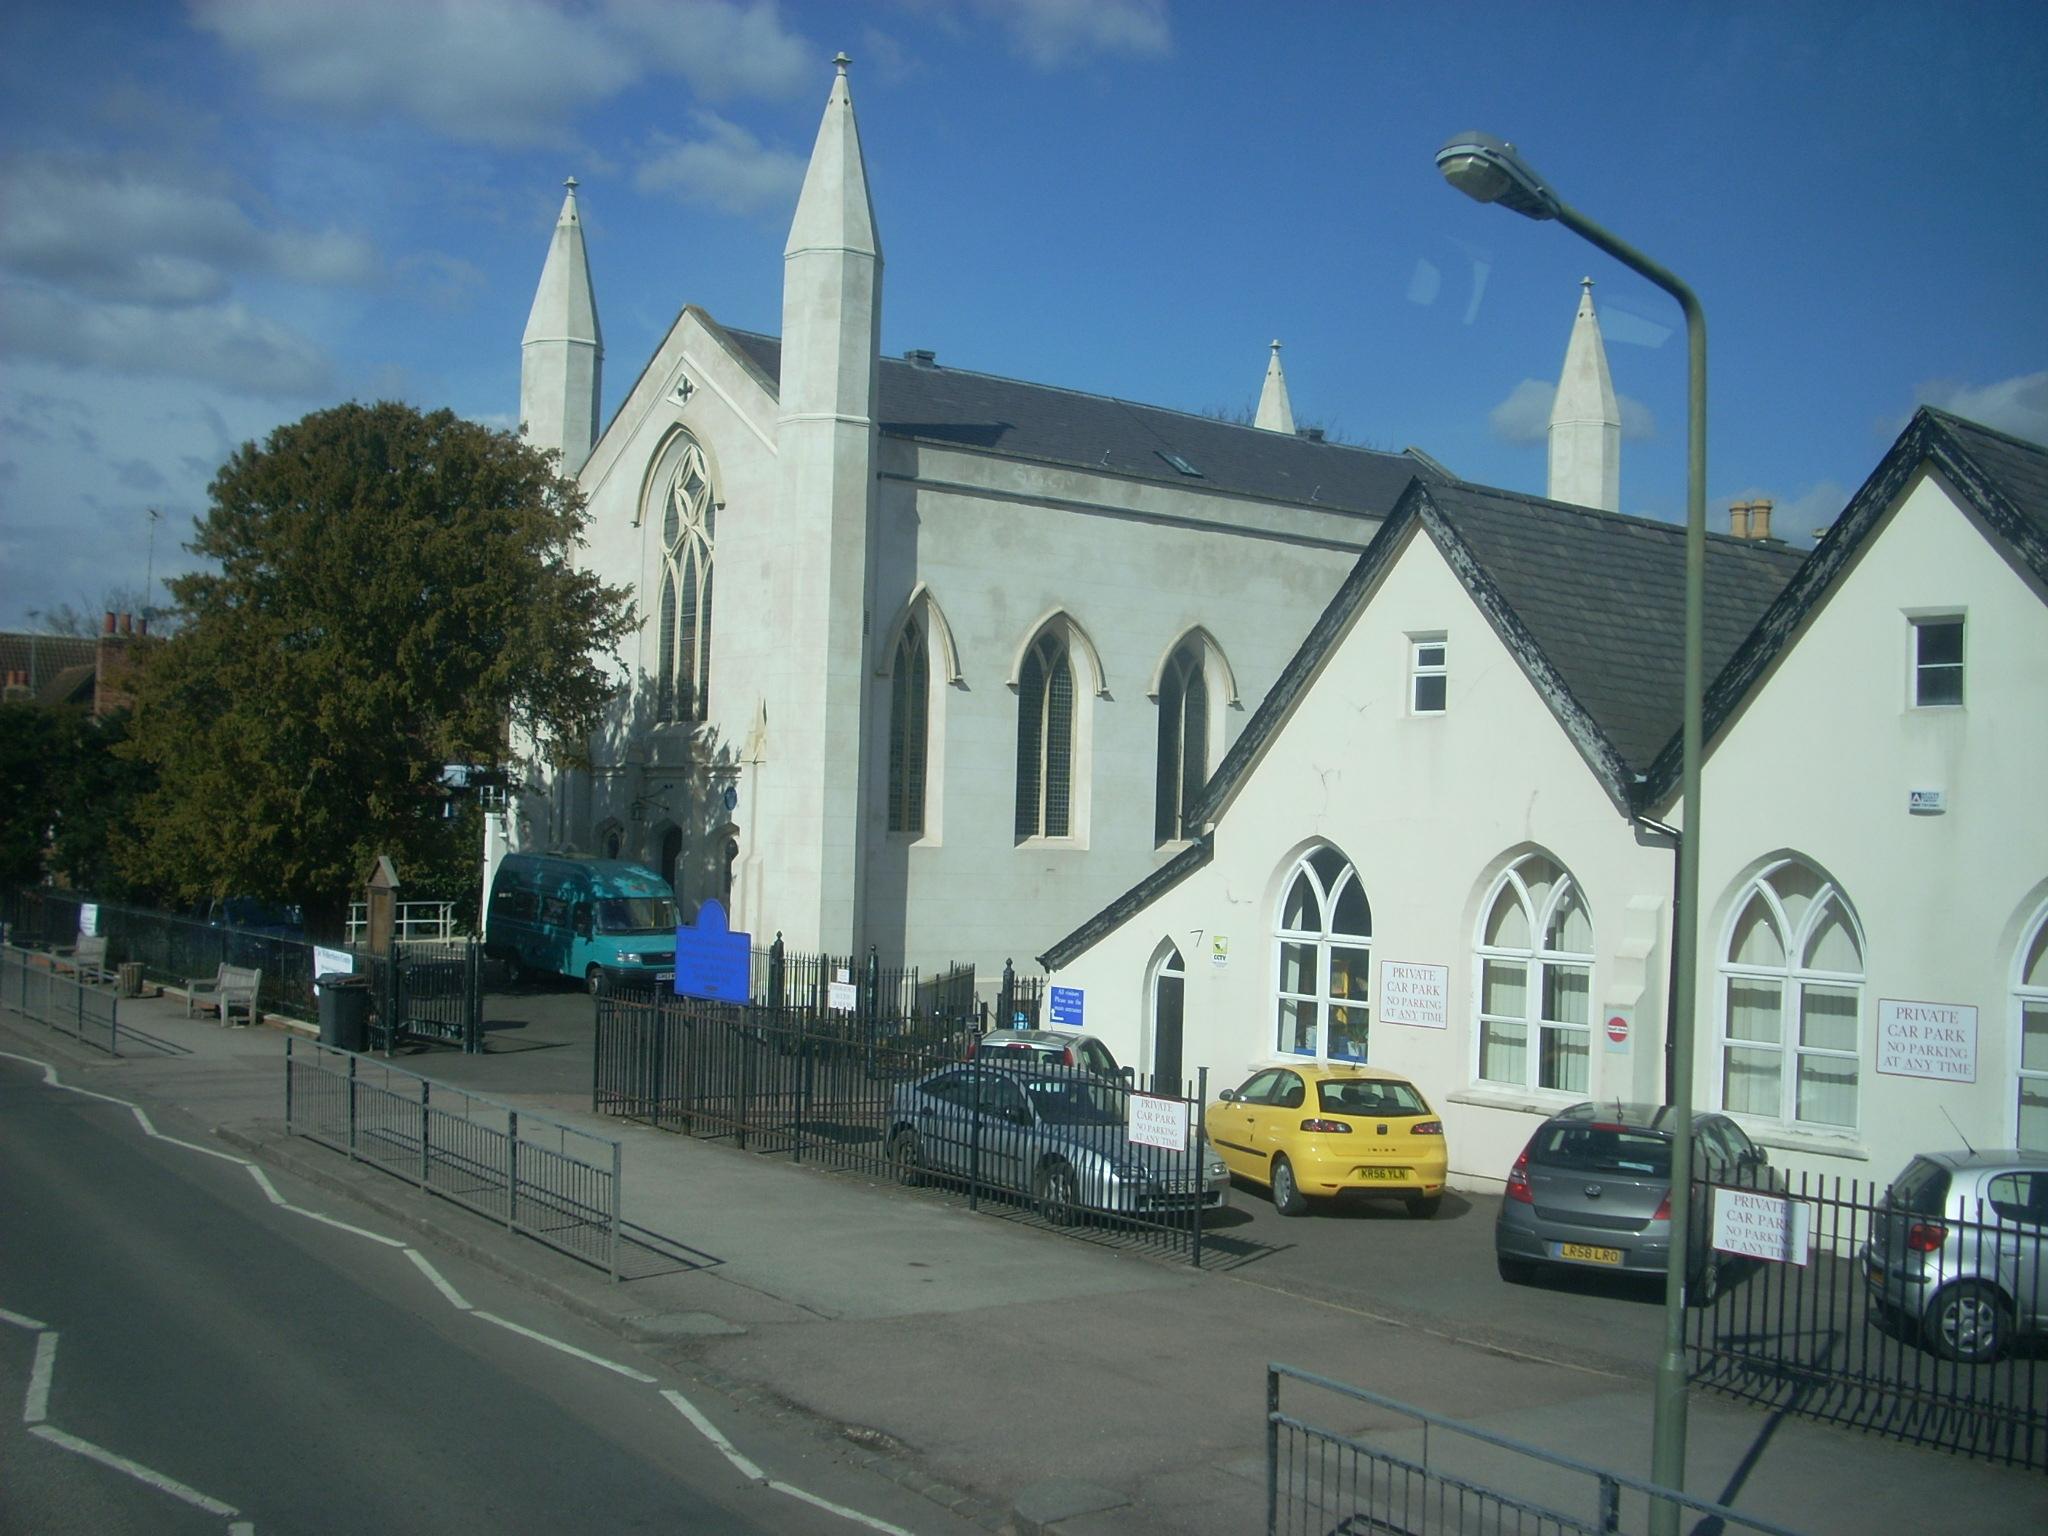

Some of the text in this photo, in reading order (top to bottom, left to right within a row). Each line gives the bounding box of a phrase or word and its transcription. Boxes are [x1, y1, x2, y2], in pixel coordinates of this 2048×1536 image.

[1393, 967, 1436, 981] PRIVATE
[1387, 981, 1440, 996] CAR PARK
[1387, 996, 1441, 1010] NO PARKING
[1385, 1008, 1443, 1022] AT ANY TIME
[1896, 1007, 1959, 1025] PRIVATE
[1887, 1024, 1965, 1043] CAR PARK
[1887, 1041, 1968, 1059] NO PARKING
[1884, 1056, 1971, 1075] AT ANY TIME
[1141, 1099, 1172, 1112] PRIVATE
[1137, 1111, 1176, 1125] CAR PARK
[1136, 1122, 1177, 1136] NO PARKING
[1146, 1135, 1160, 1144] ANY
[1162, 1138, 1178, 1147] TIME
[1361, 1168, 1405, 1179] KR56 YLN
[1734, 1195, 1787, 1214] PRIVATE
[1727, 1209, 1793, 1232] CAR PARK
[1726, 1225, 1742, 1237] NO
[1562, 1245, 1618, 1262] LR58 LRO
[1725, 1239, 1736, 1248] AT
[1742, 1241, 1762, 1254] ANY
